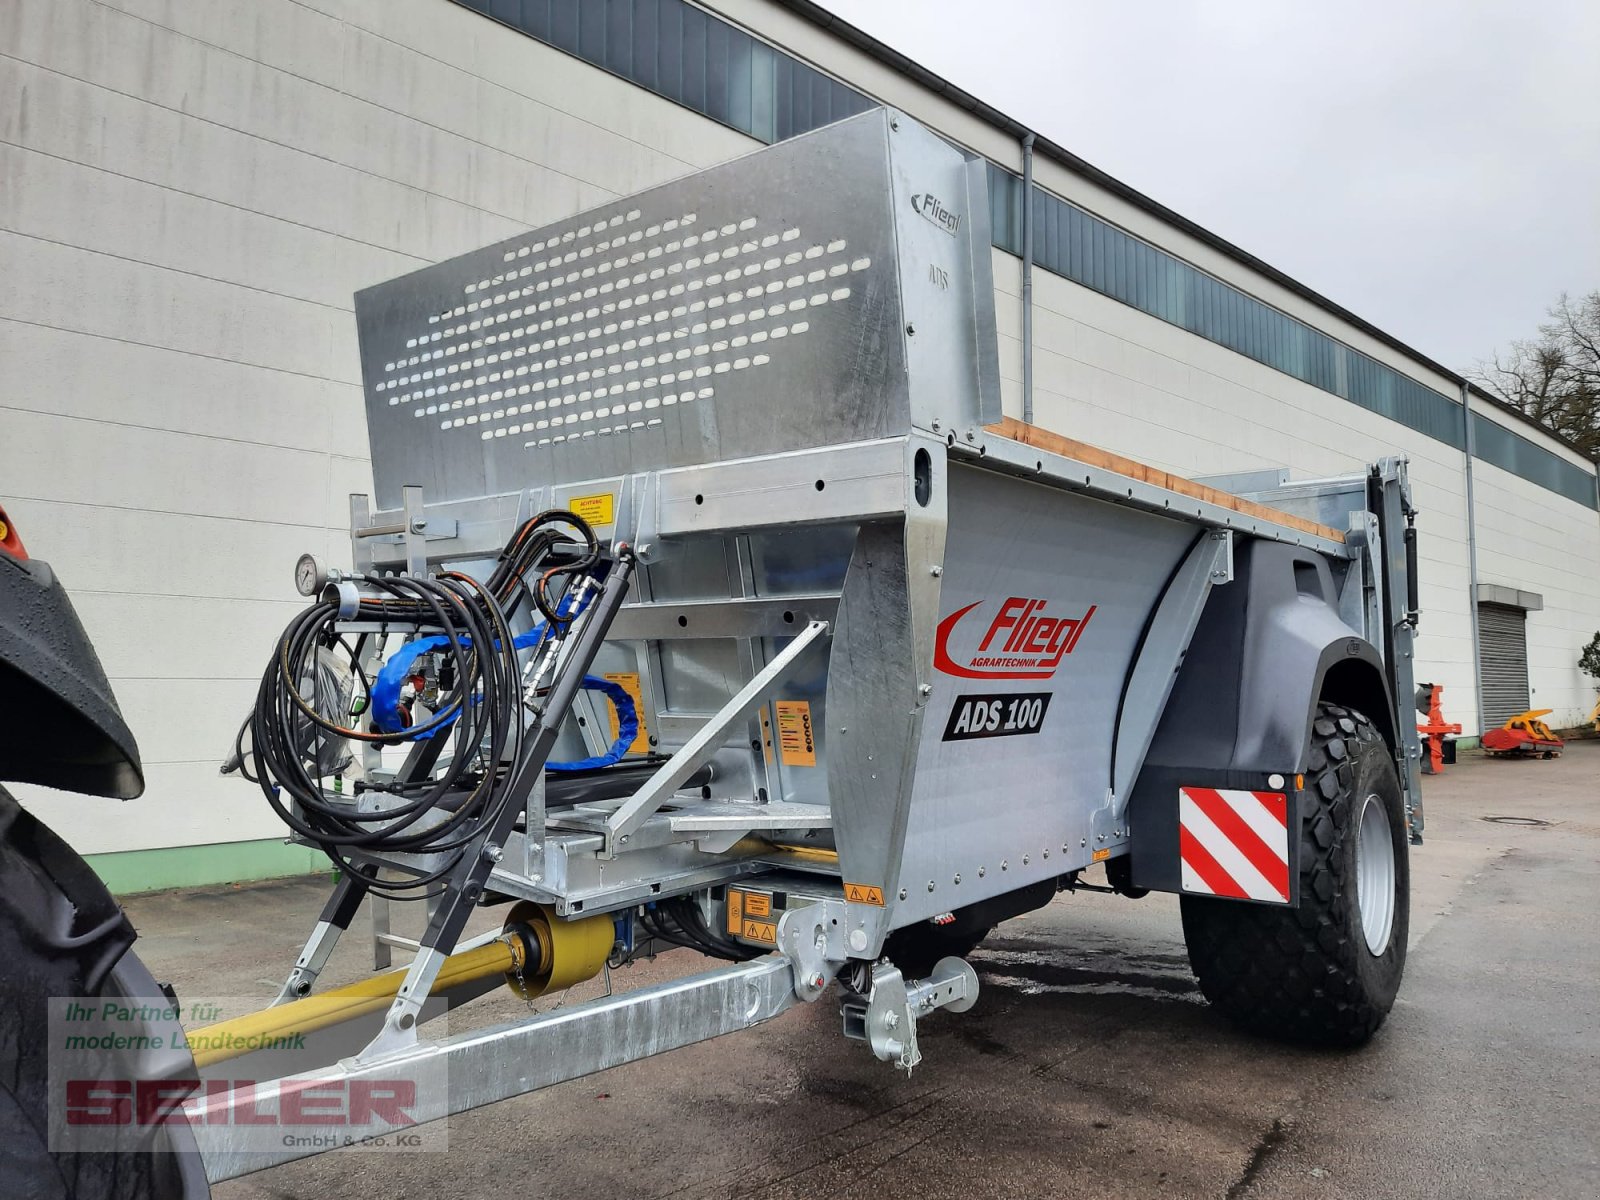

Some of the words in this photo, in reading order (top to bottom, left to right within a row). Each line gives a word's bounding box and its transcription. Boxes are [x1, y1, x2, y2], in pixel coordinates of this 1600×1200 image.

[923, 194, 961, 231] Fliegl
[978, 596, 1097, 667] Fliegl
[970, 658, 1038, 667] AGRARTECHNIK
[954, 701, 1002, 733] ADS
[1004, 699, 1042, 729] 100
